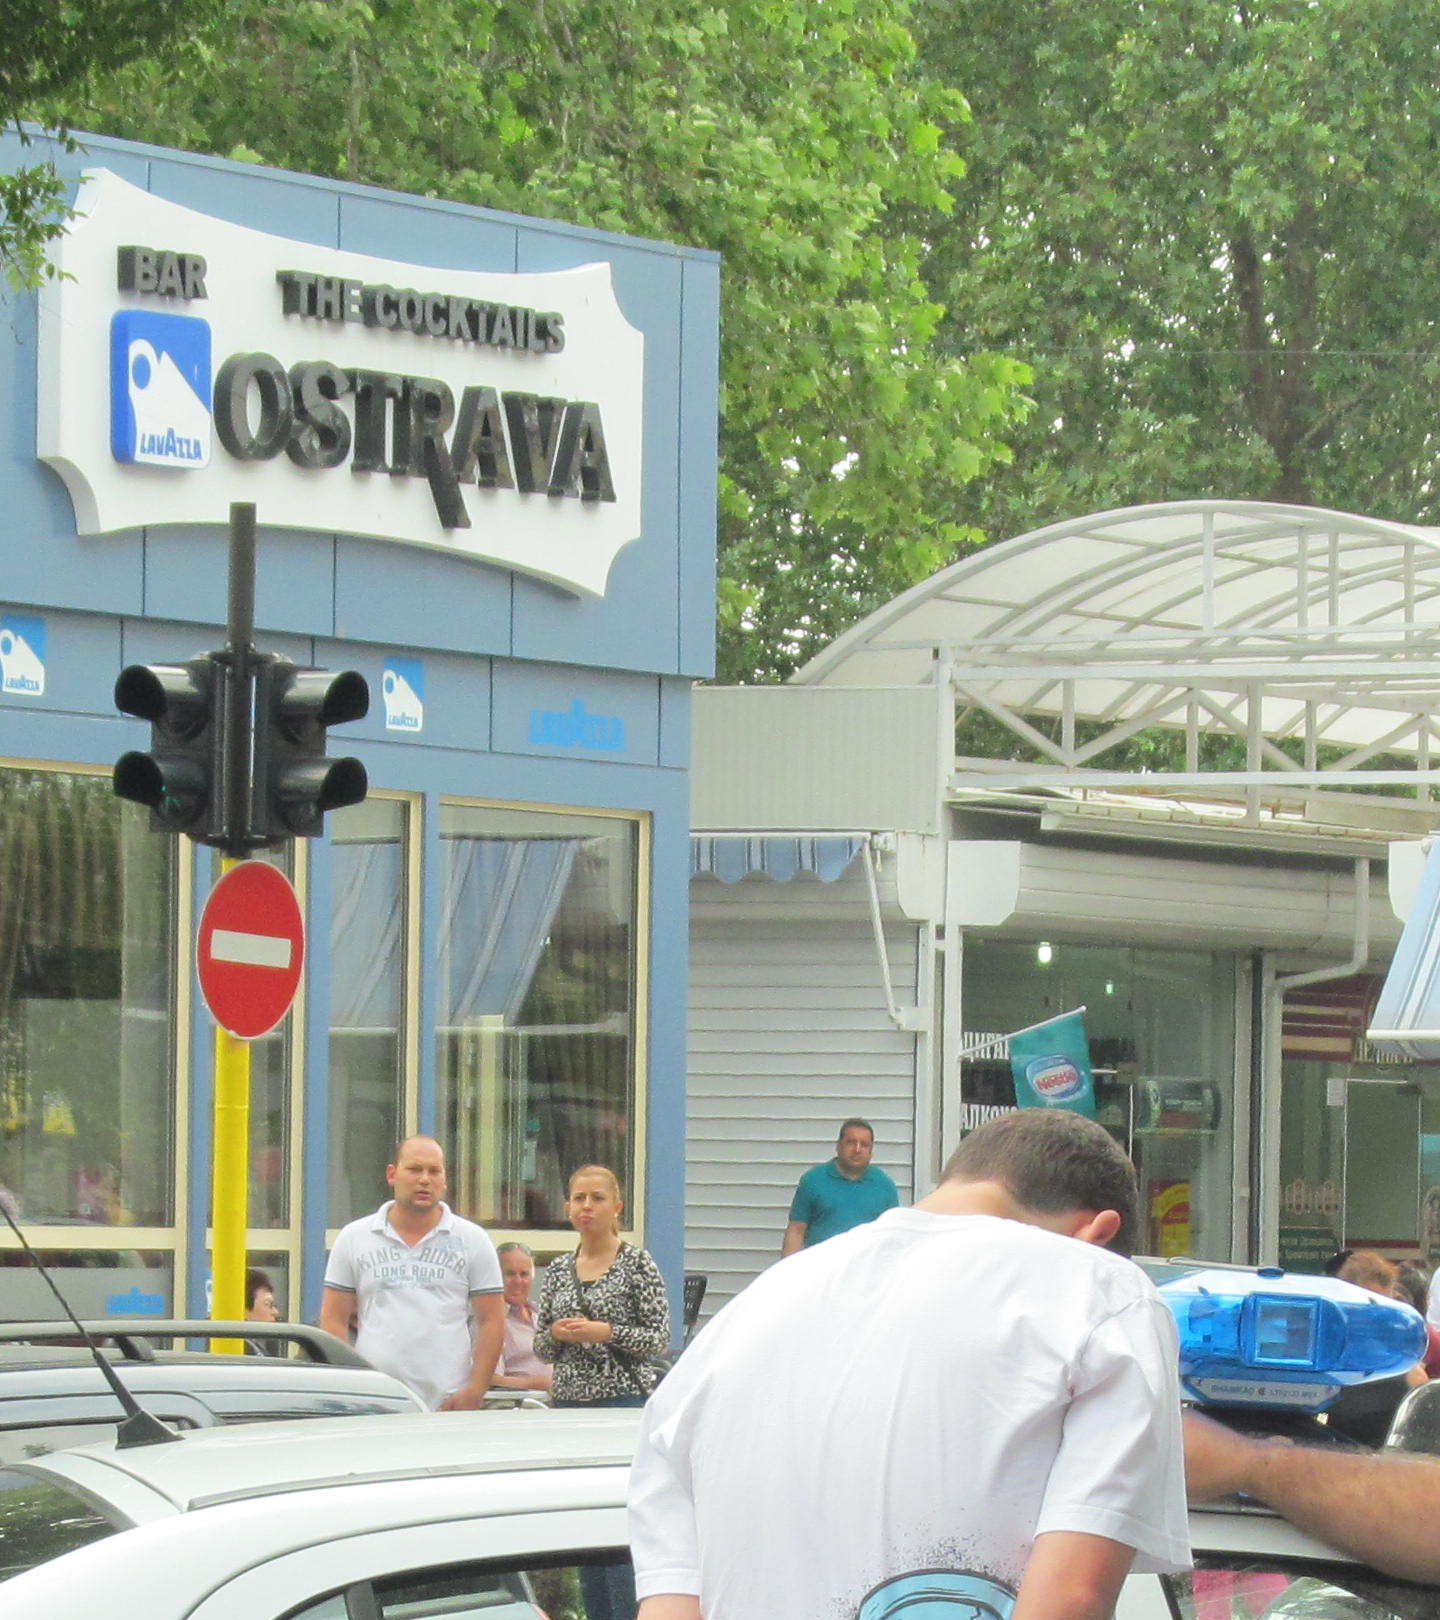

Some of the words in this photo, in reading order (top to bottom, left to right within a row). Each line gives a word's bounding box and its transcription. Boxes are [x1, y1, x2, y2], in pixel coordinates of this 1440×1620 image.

[118, 245, 208, 299] BAR
[277, 270, 362, 323] THE
[364, 284, 566, 354] COCKTAILS
[140, 428, 203, 460] LAVAZZA
[213, 352, 617, 528] OSTRAVA
[528, 698, 624, 750] LAVAZZA
[357, 1247, 400, 1271] KING
[419, 1247, 466, 1275] RIDER
[374, 1264, 406, 1278] LONG
[412, 1264, 446, 1281] ROAD
